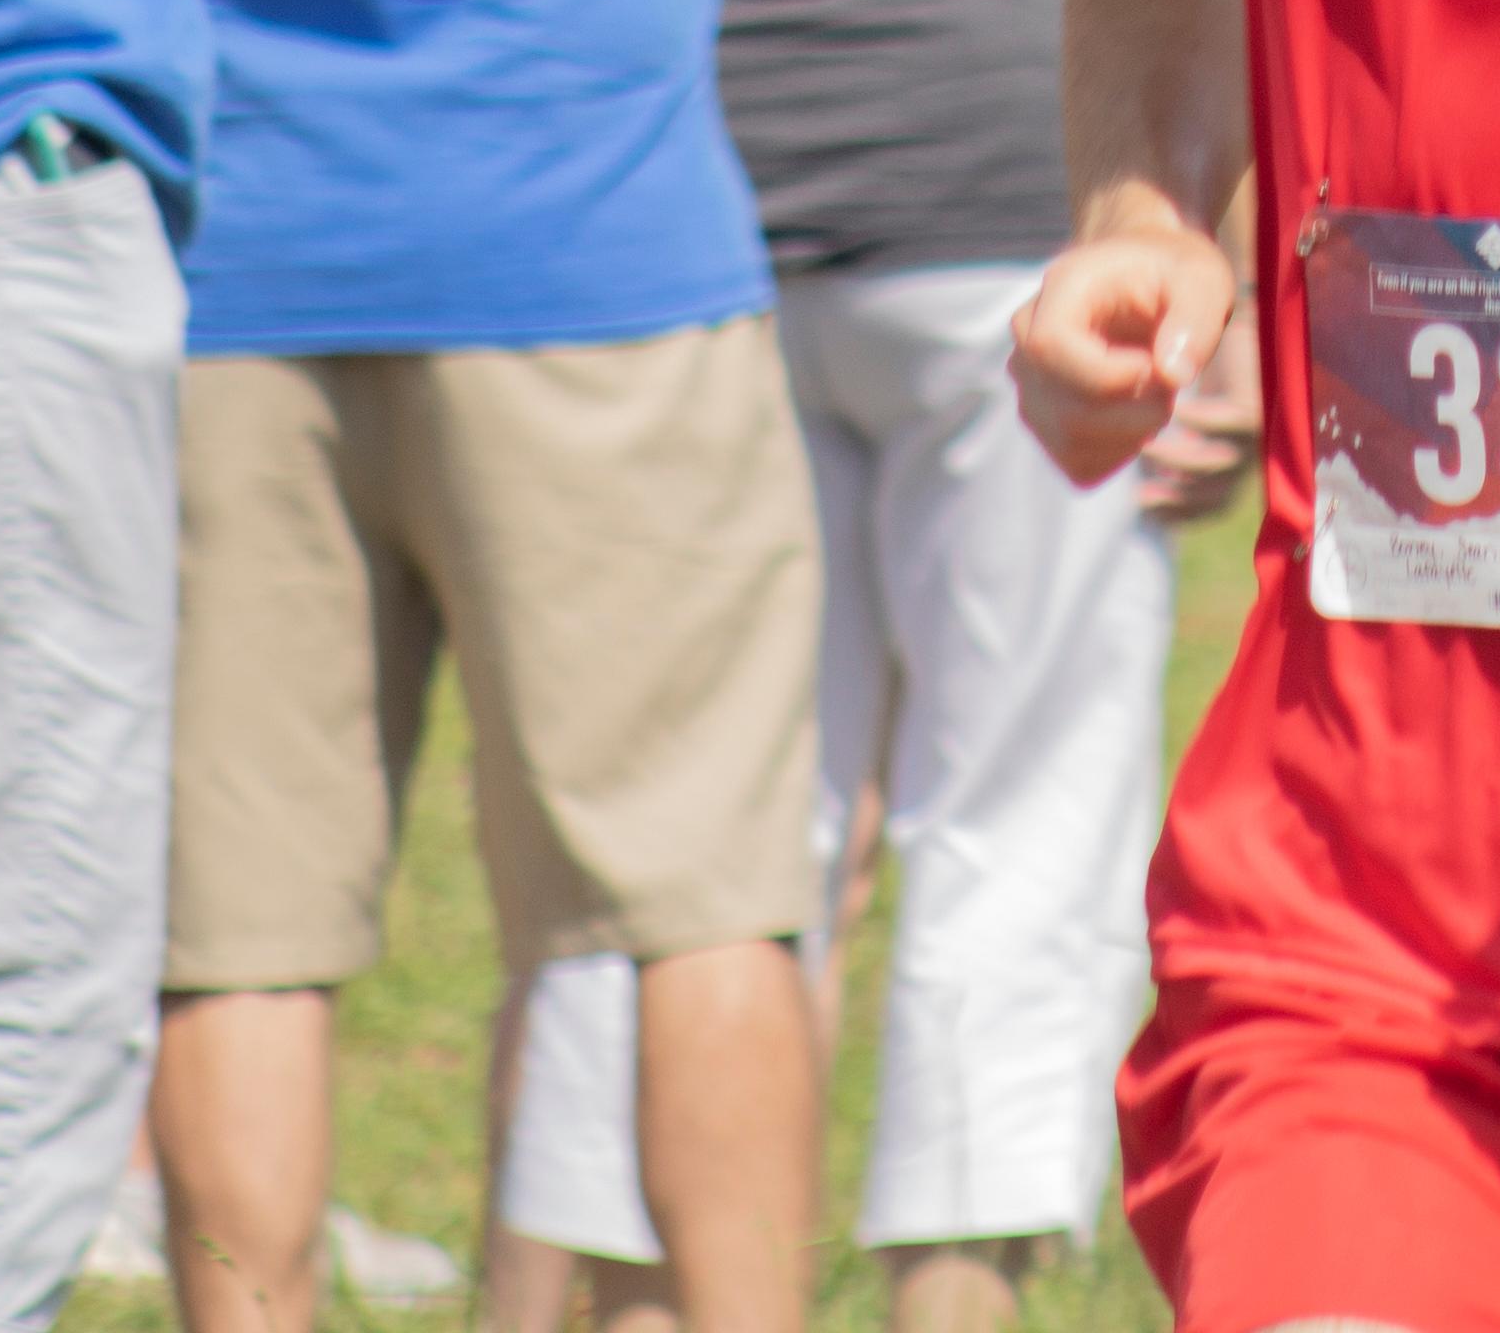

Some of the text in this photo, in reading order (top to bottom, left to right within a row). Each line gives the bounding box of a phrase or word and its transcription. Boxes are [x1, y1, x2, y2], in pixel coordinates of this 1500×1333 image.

[1377, 270, 1399, 291] Even
[1400, 271, 1409, 292] if
[1410, 276, 1427, 296] you
[1428, 278, 1443, 294] are
[1445, 279, 1457, 295] on
[1460, 276, 1475, 296] the
